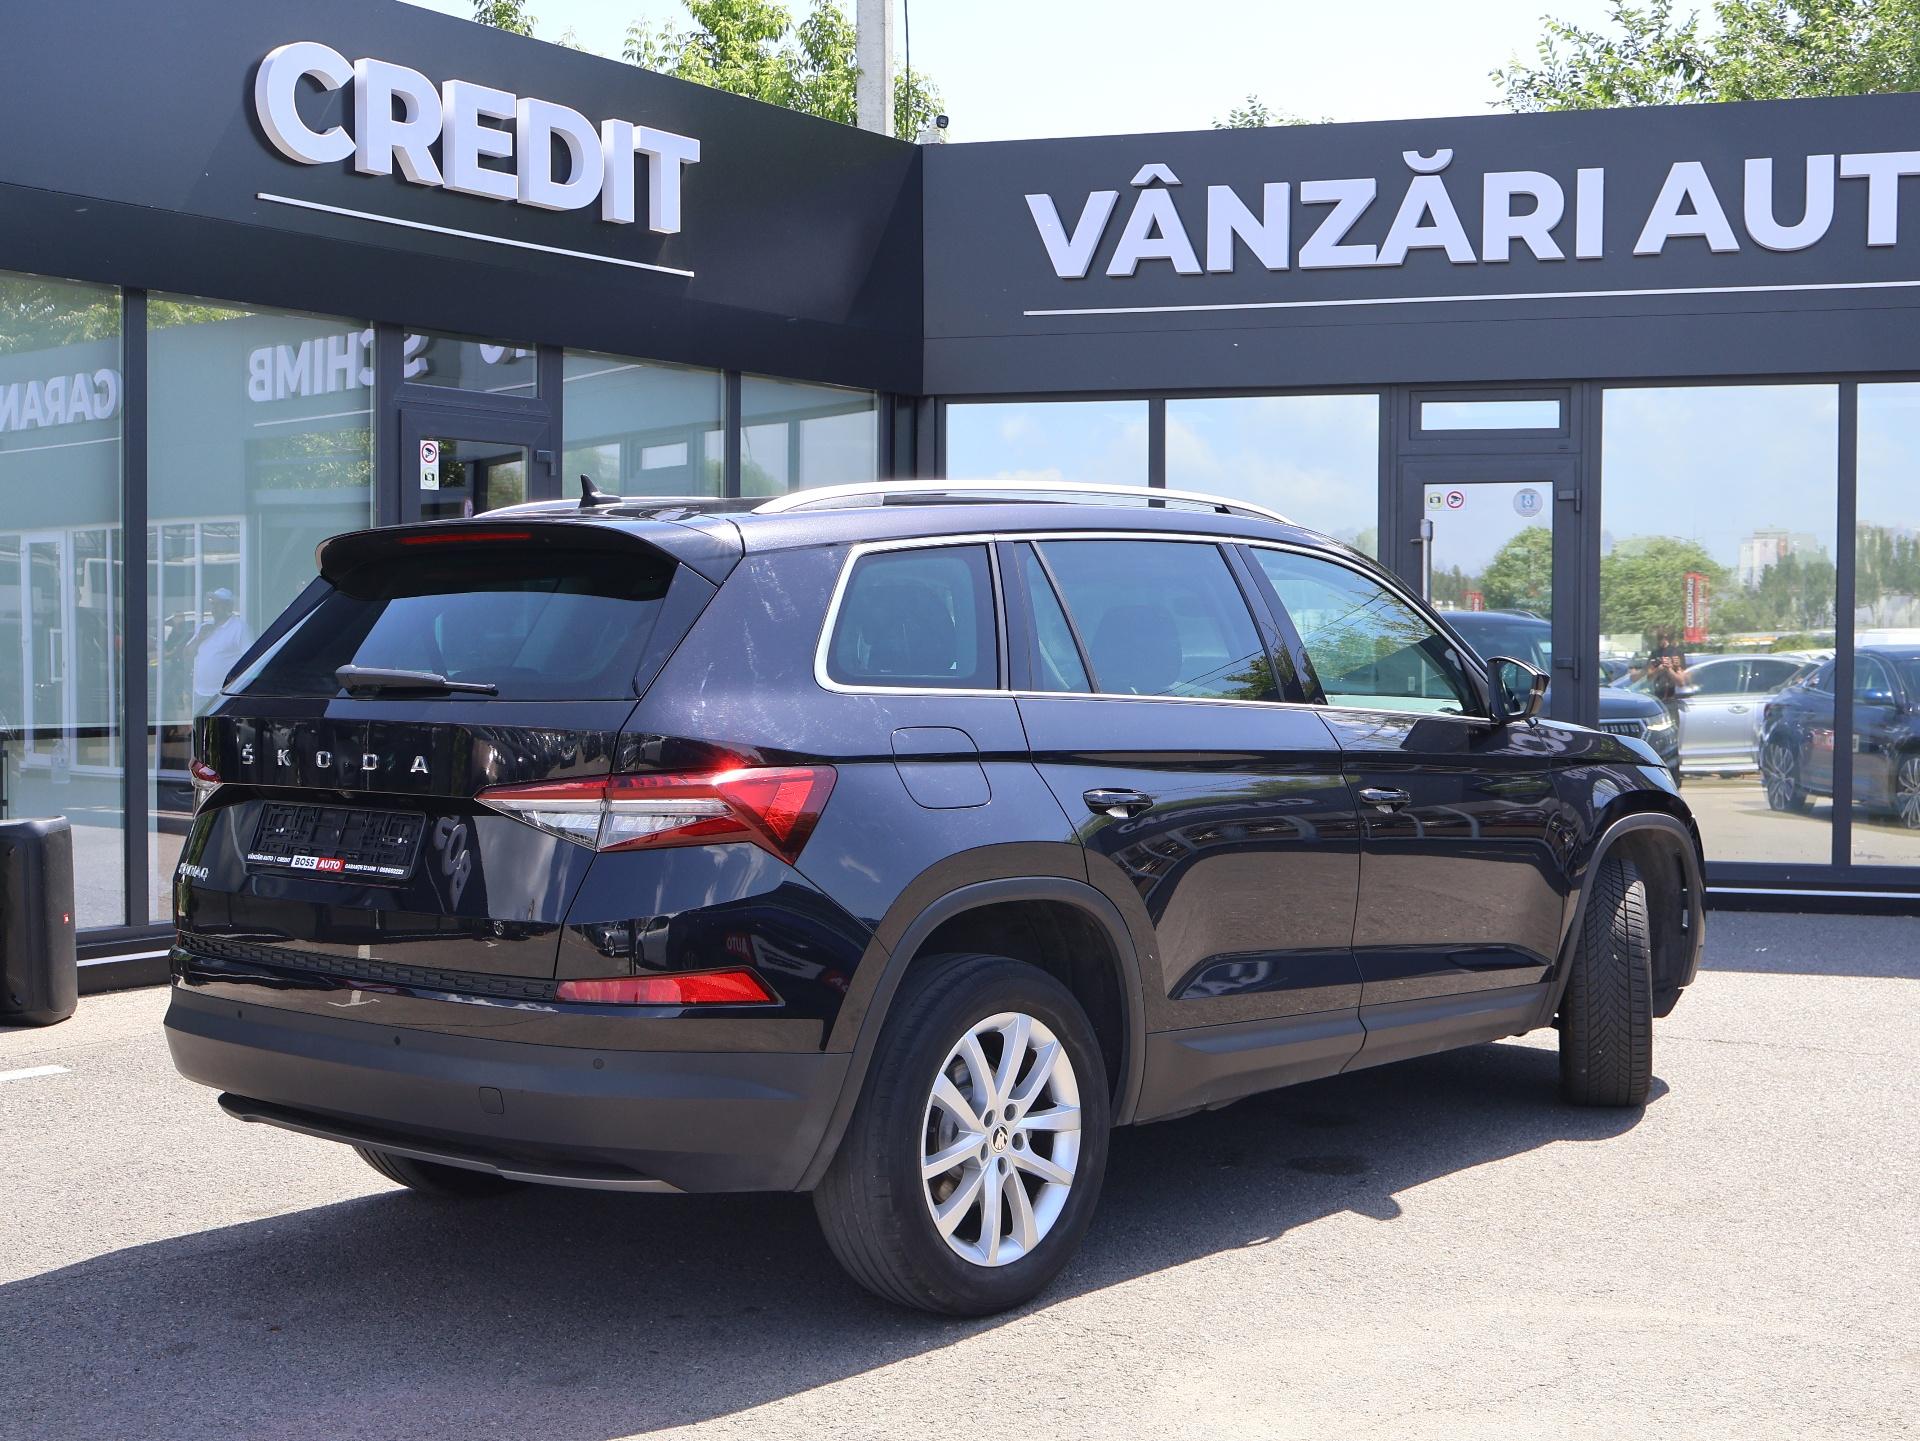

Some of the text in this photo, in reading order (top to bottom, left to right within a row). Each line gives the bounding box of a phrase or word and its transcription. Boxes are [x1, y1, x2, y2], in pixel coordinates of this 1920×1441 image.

[255, 41, 700, 234] CREDIT
[1024, 149, 1604, 279] VÂNZĂRI
[242, 743, 429, 774] ŠKODA
[295, 857, 315, 867] BOSS
[318, 859, 341, 870] AUTO
